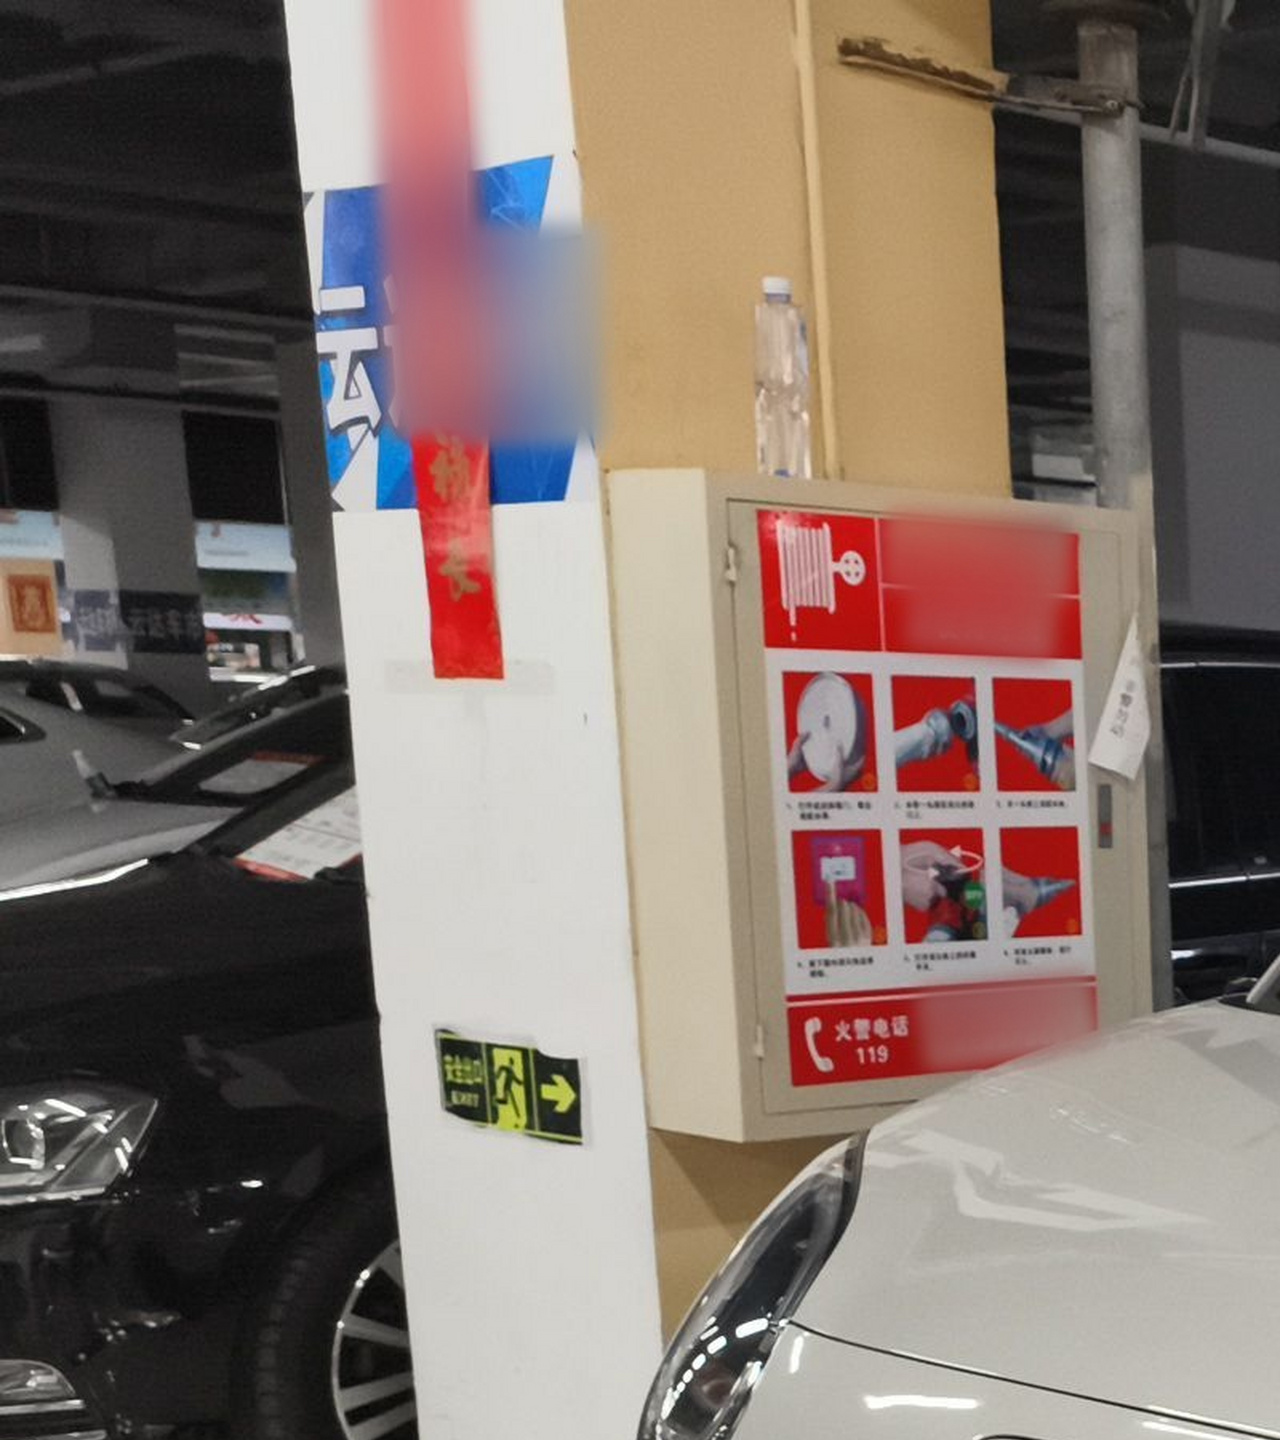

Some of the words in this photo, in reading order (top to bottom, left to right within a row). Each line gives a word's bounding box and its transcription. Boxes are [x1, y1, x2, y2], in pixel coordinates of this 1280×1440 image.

[834, 1014, 908, 1042] 火警电话
[856, 1045, 888, 1064] 119
